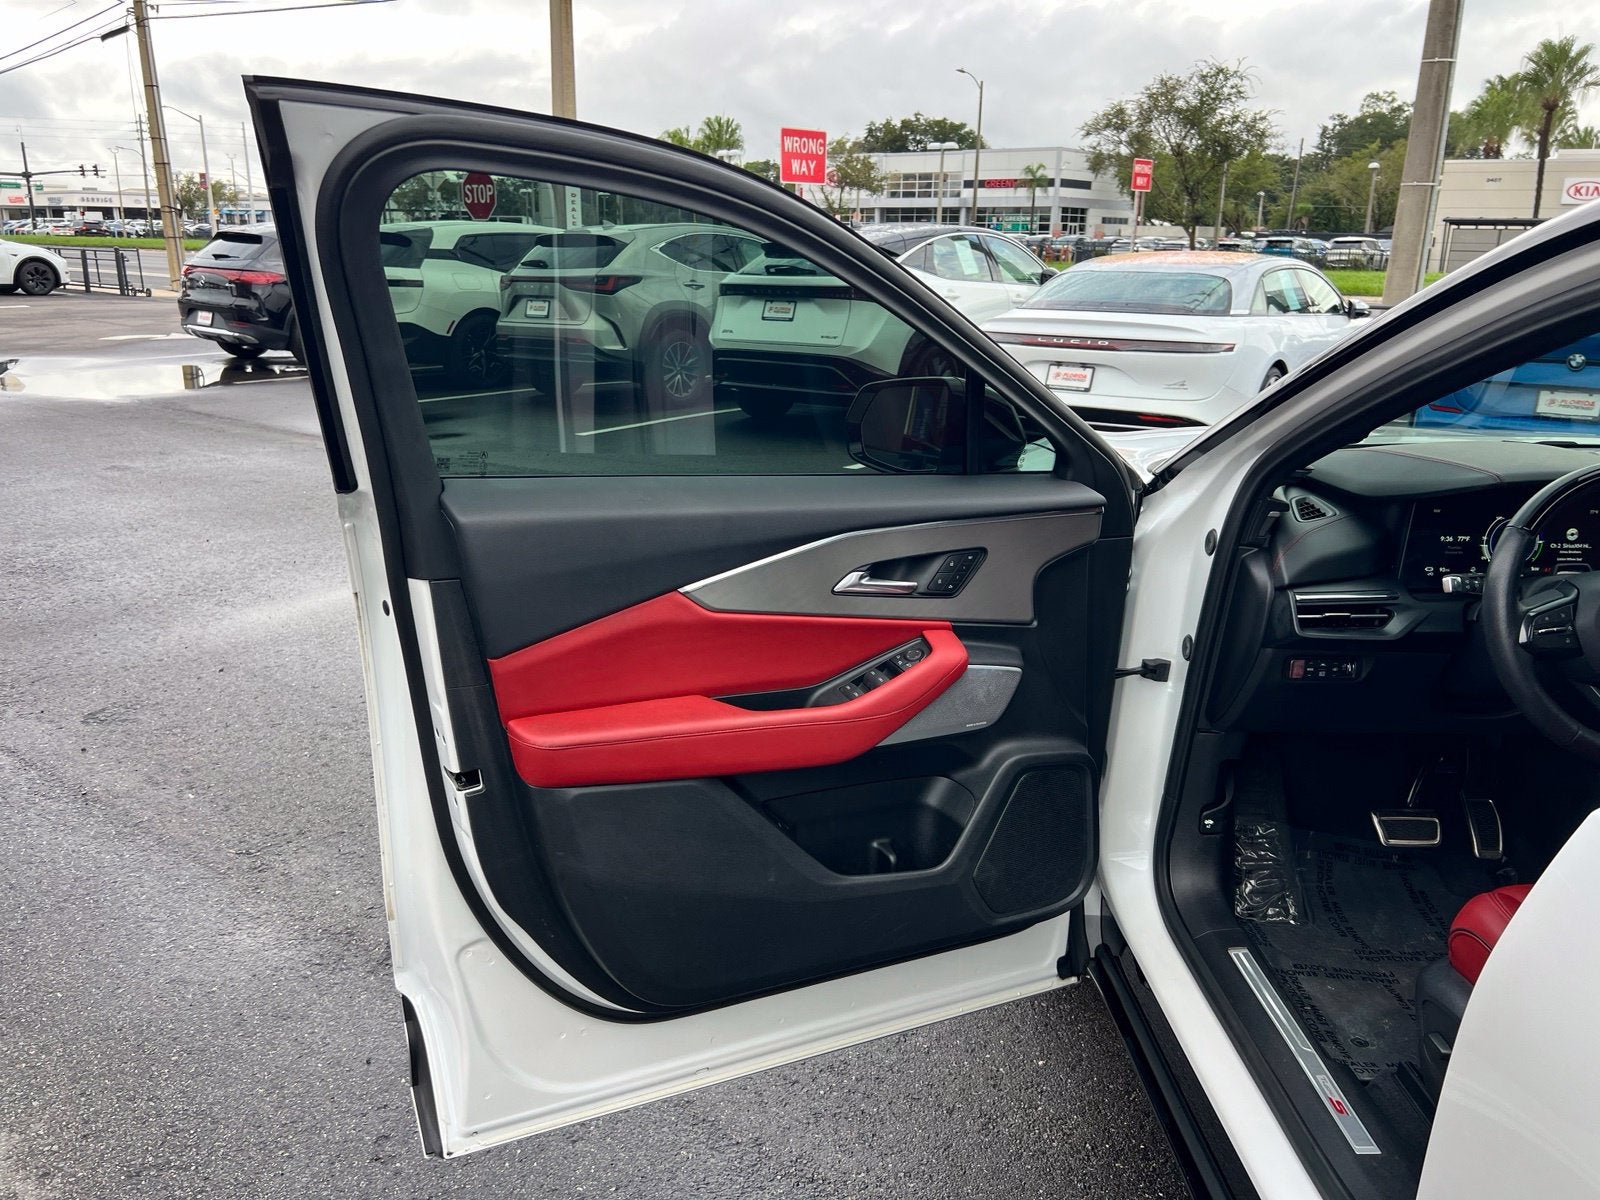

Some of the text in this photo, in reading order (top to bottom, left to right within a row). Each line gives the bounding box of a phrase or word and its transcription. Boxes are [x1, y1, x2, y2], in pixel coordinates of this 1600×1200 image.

[783, 135, 825, 156] WRONG
[791, 158, 817, 177] WAY
[1134, 163, 1153, 175] WRONG
[1135, 176, 1149, 187] WAY
[464, 184, 494, 204] STOP
[1062, 371, 1088, 379] FLORIDA
[1560, 398, 1596, 407] FLORIDA
